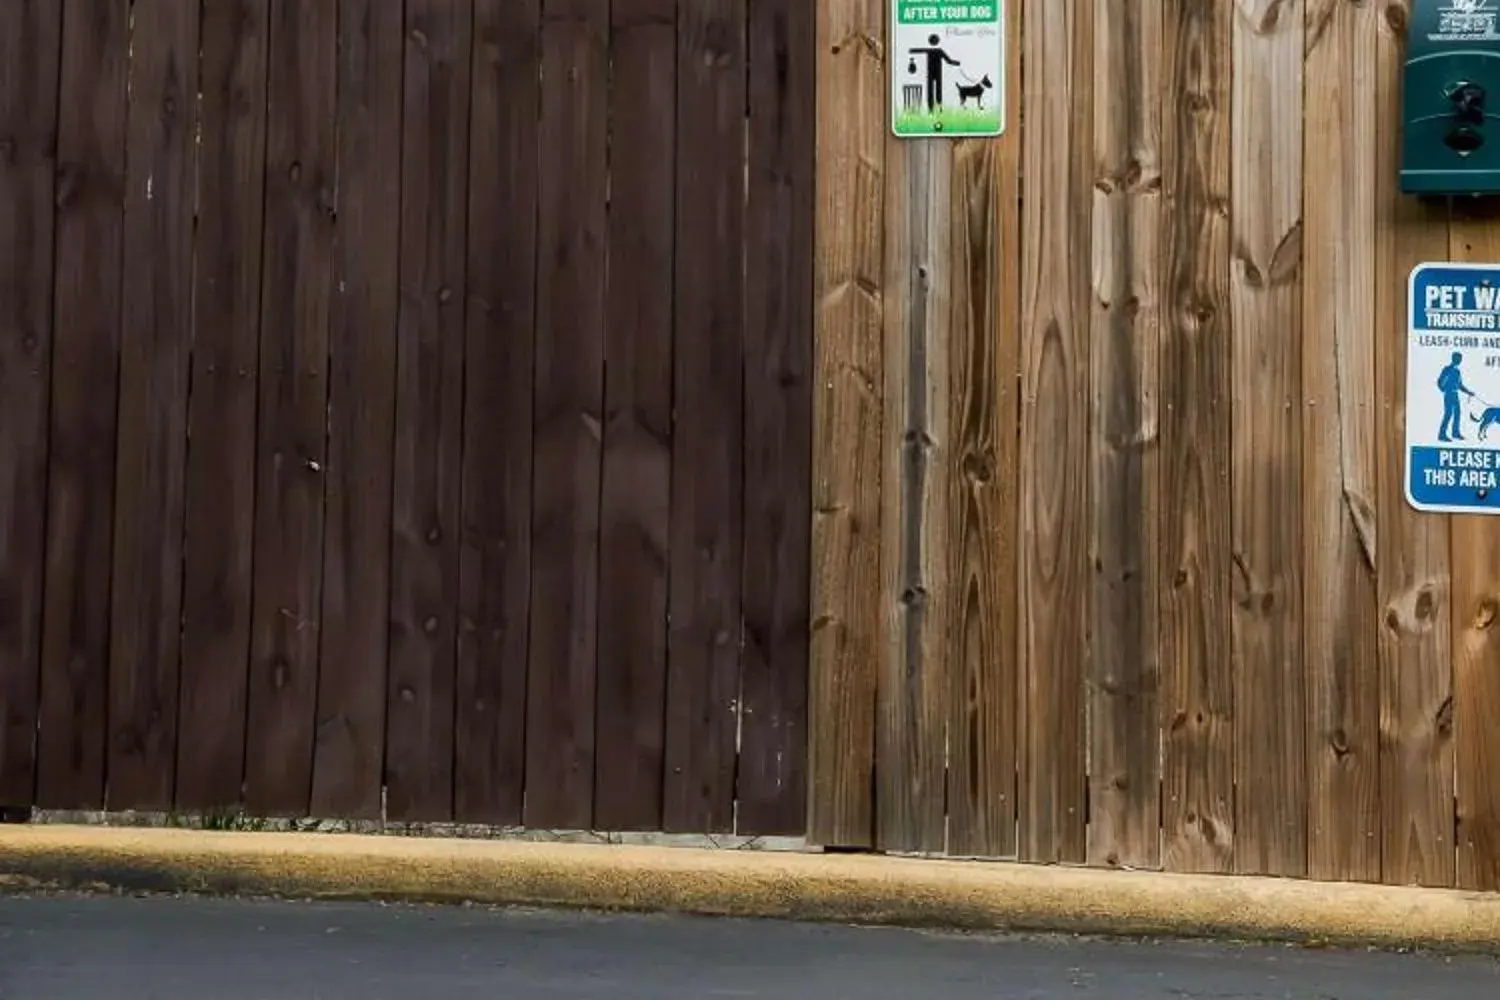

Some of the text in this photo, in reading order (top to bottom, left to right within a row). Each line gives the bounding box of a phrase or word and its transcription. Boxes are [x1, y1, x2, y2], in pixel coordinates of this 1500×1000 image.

[904, 6, 992, 20] AFTER YOUR DOG
[1425, 285, 1466, 309] PET
[1426, 312, 1495, 329] TRANSMITS
[1439, 450, 1491, 468] PLEASE
[1424, 469, 1455, 486] THIS
[1459, 471, 1497, 488] AREA
